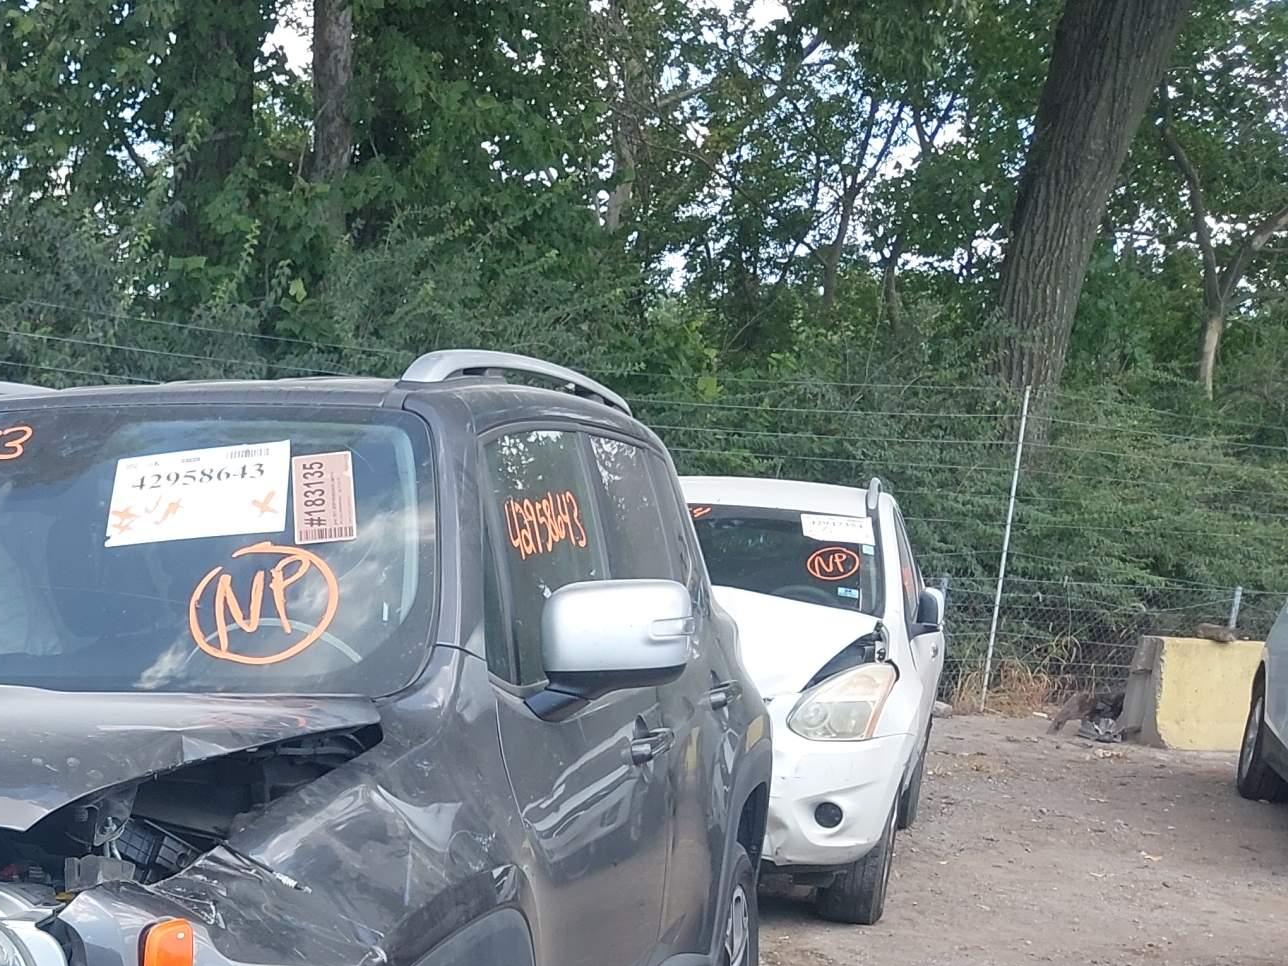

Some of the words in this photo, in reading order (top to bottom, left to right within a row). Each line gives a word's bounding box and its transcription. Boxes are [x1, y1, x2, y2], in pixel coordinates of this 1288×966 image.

[130, 462, 265, 491] 42958643
[302, 461, 328, 528] #183135
[813, 552, 848, 578] NP
[213, 553, 314, 654] NP
